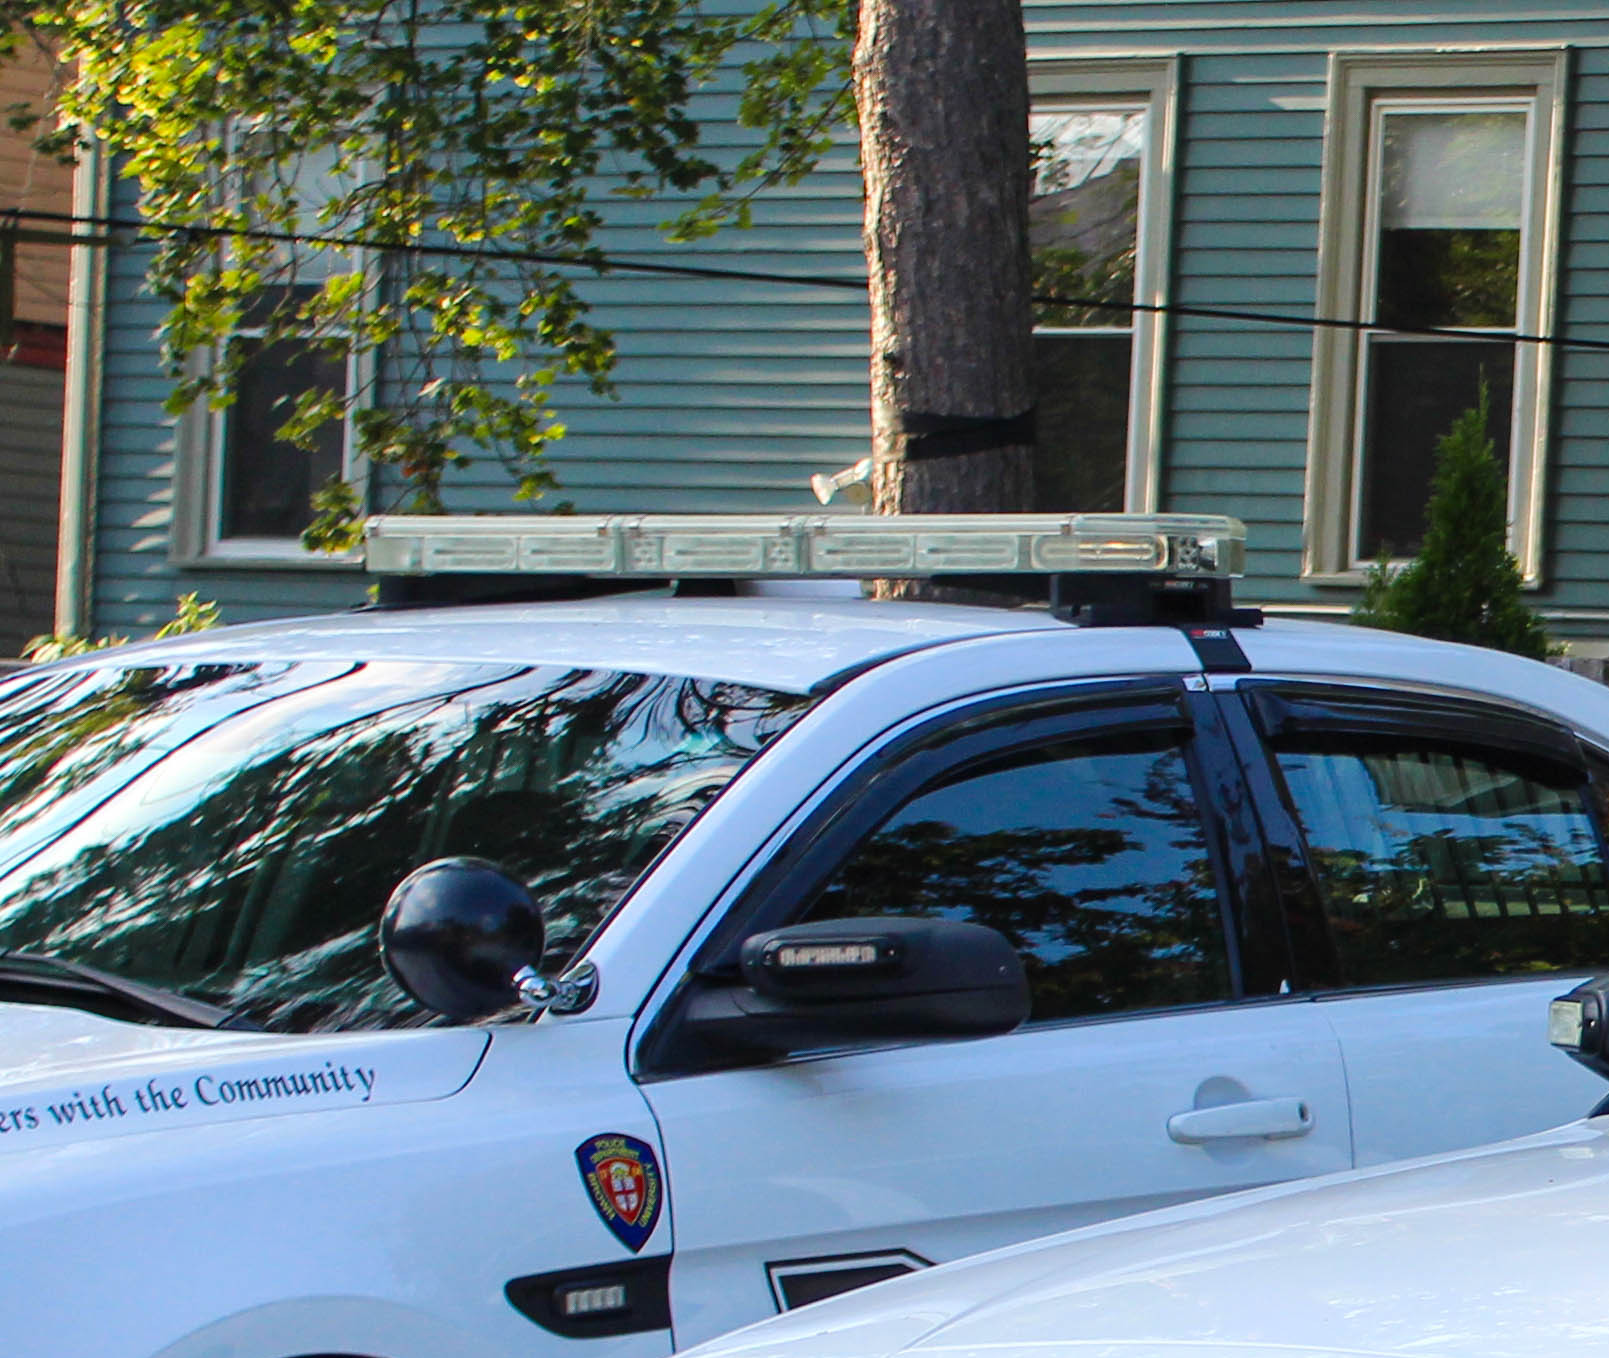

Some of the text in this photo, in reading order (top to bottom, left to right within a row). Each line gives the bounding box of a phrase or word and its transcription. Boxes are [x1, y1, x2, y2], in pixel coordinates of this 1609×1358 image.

[48, 1085, 127, 1125] with
[136, 1078, 187, 1113] the
[194, 1062, 376, 1103] Community
